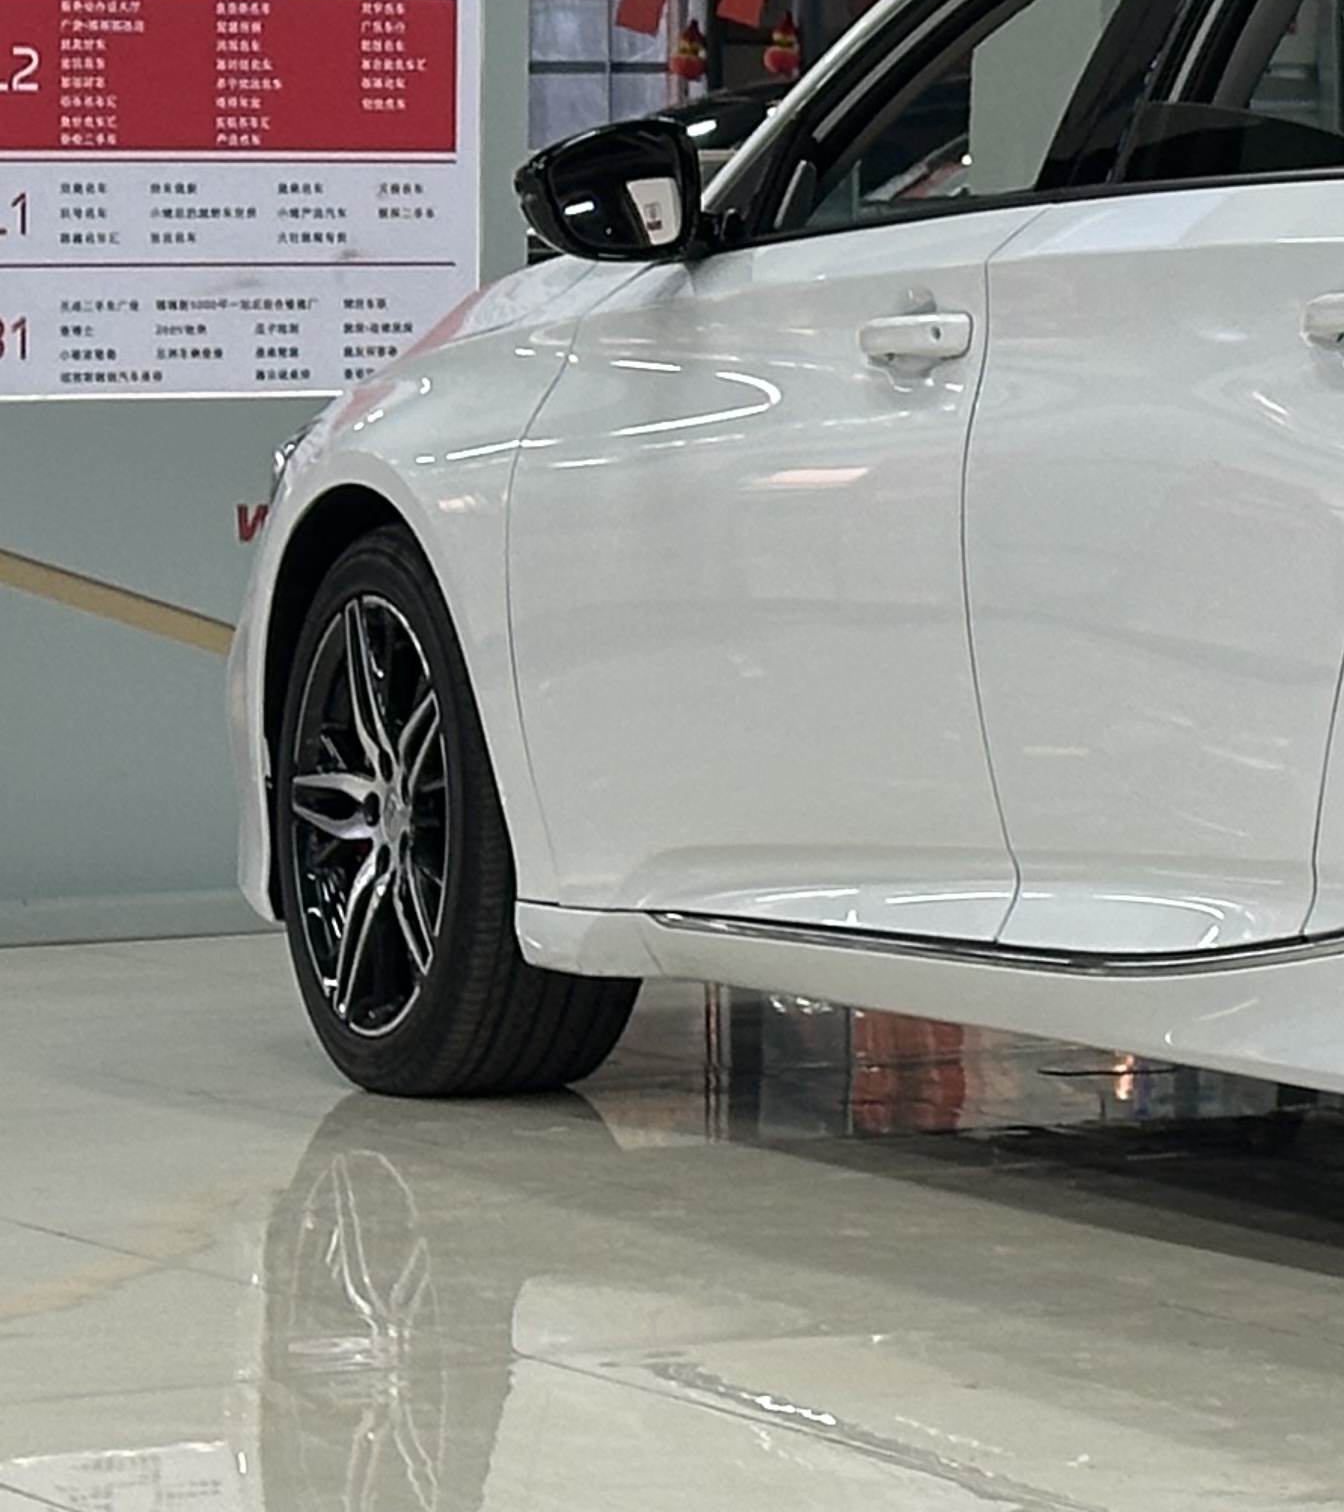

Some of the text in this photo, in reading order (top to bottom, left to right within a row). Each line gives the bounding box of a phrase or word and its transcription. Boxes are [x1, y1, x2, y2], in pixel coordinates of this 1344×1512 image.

[0, 48, 38, 90] 2
[0, 192, 27, 236] 1
[0, 316, 27, 360] 1
